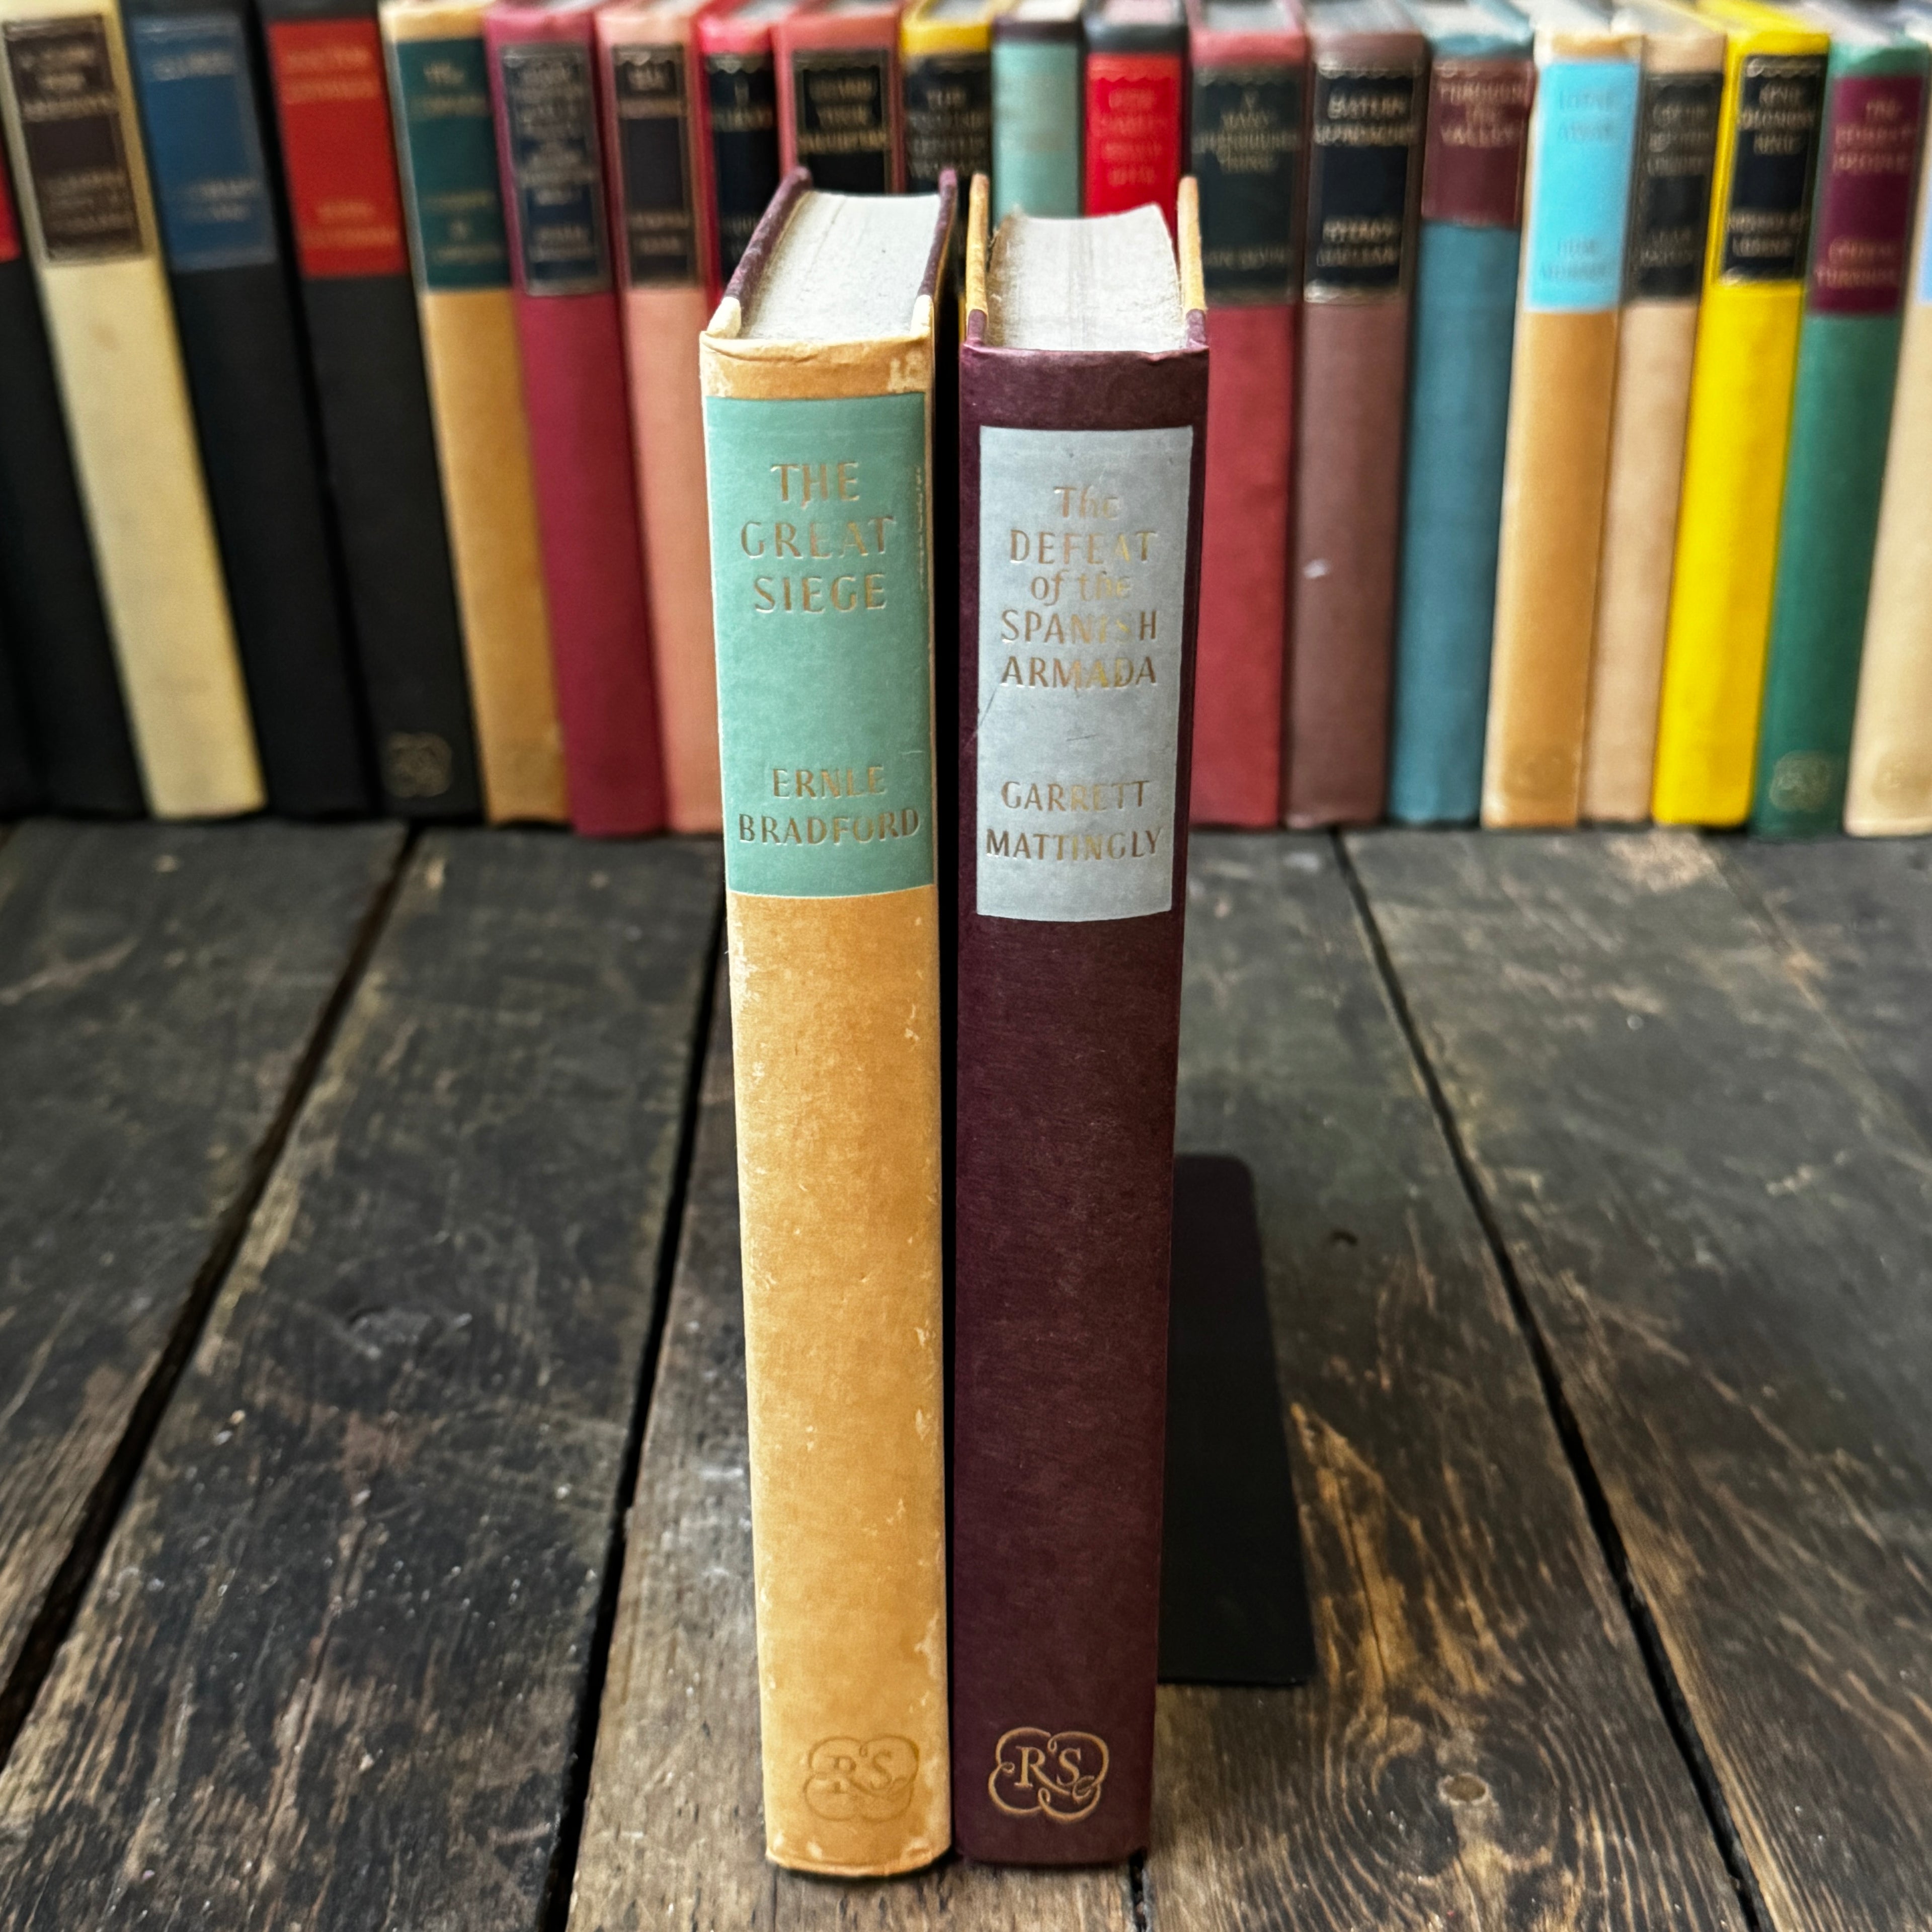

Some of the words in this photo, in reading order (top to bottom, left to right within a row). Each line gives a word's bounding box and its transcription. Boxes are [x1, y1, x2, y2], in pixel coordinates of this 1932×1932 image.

[770, 461, 860, 509] THE
[1054, 485, 1121, 521] The
[741, 515, 897, 559] GREAT
[1009, 529, 1157, 565] DEFEAT
[754, 573, 888, 614] SIEGE
[1030, 569, 1070, 607] of
[1078, 570, 1132, 603] the
[1000, 609, 1157, 644] SPANISH
[1000, 656, 1157, 689] ARMADA
[772, 764, 888, 799] ERNLE
[1001, 780, 1150, 812] GARRETT
[739, 808, 922, 845] BRADFORD
[986, 826, 1165, 861] MATTINGLY
